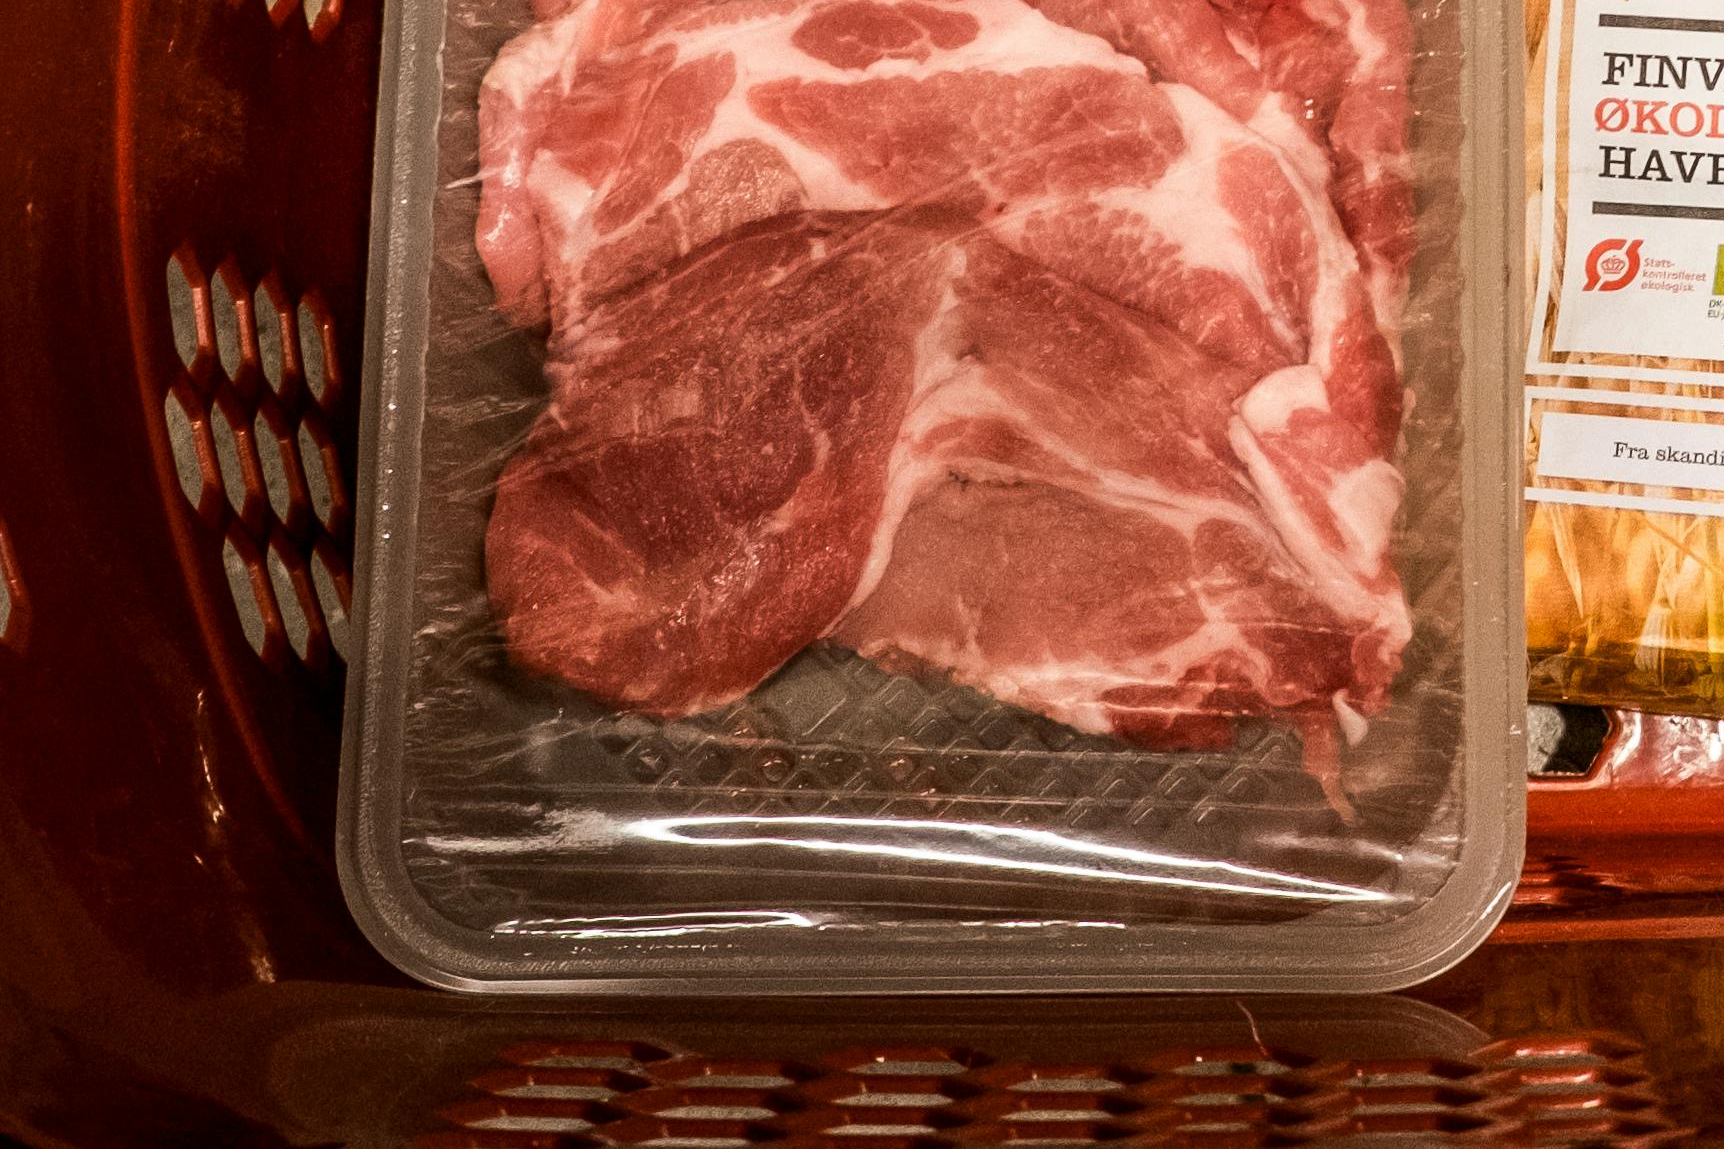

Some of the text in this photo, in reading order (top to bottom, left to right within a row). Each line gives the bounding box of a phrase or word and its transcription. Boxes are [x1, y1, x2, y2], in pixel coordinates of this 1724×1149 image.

[1642, 270, 1706, 282] kontrolleret
[1640, 282, 1694, 294] økologisk
[1613, 441, 1650, 461] Fra
